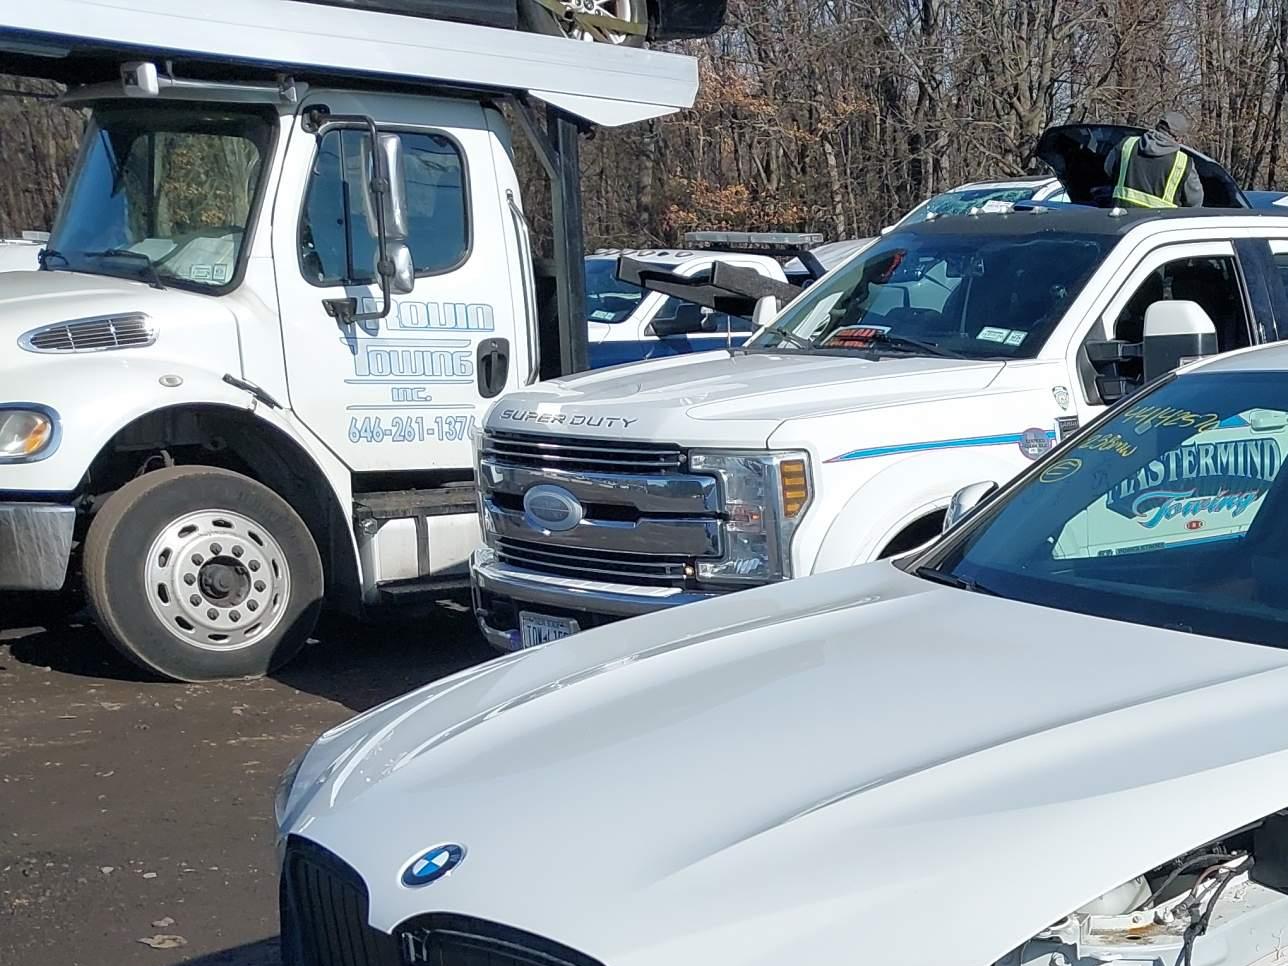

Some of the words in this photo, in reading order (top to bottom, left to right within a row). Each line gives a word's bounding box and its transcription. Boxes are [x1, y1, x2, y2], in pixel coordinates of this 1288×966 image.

[501, 409, 566, 424] SUPER
[569, 415, 638, 428] DUTY
[1132, 487, 1259, 528] Towing
